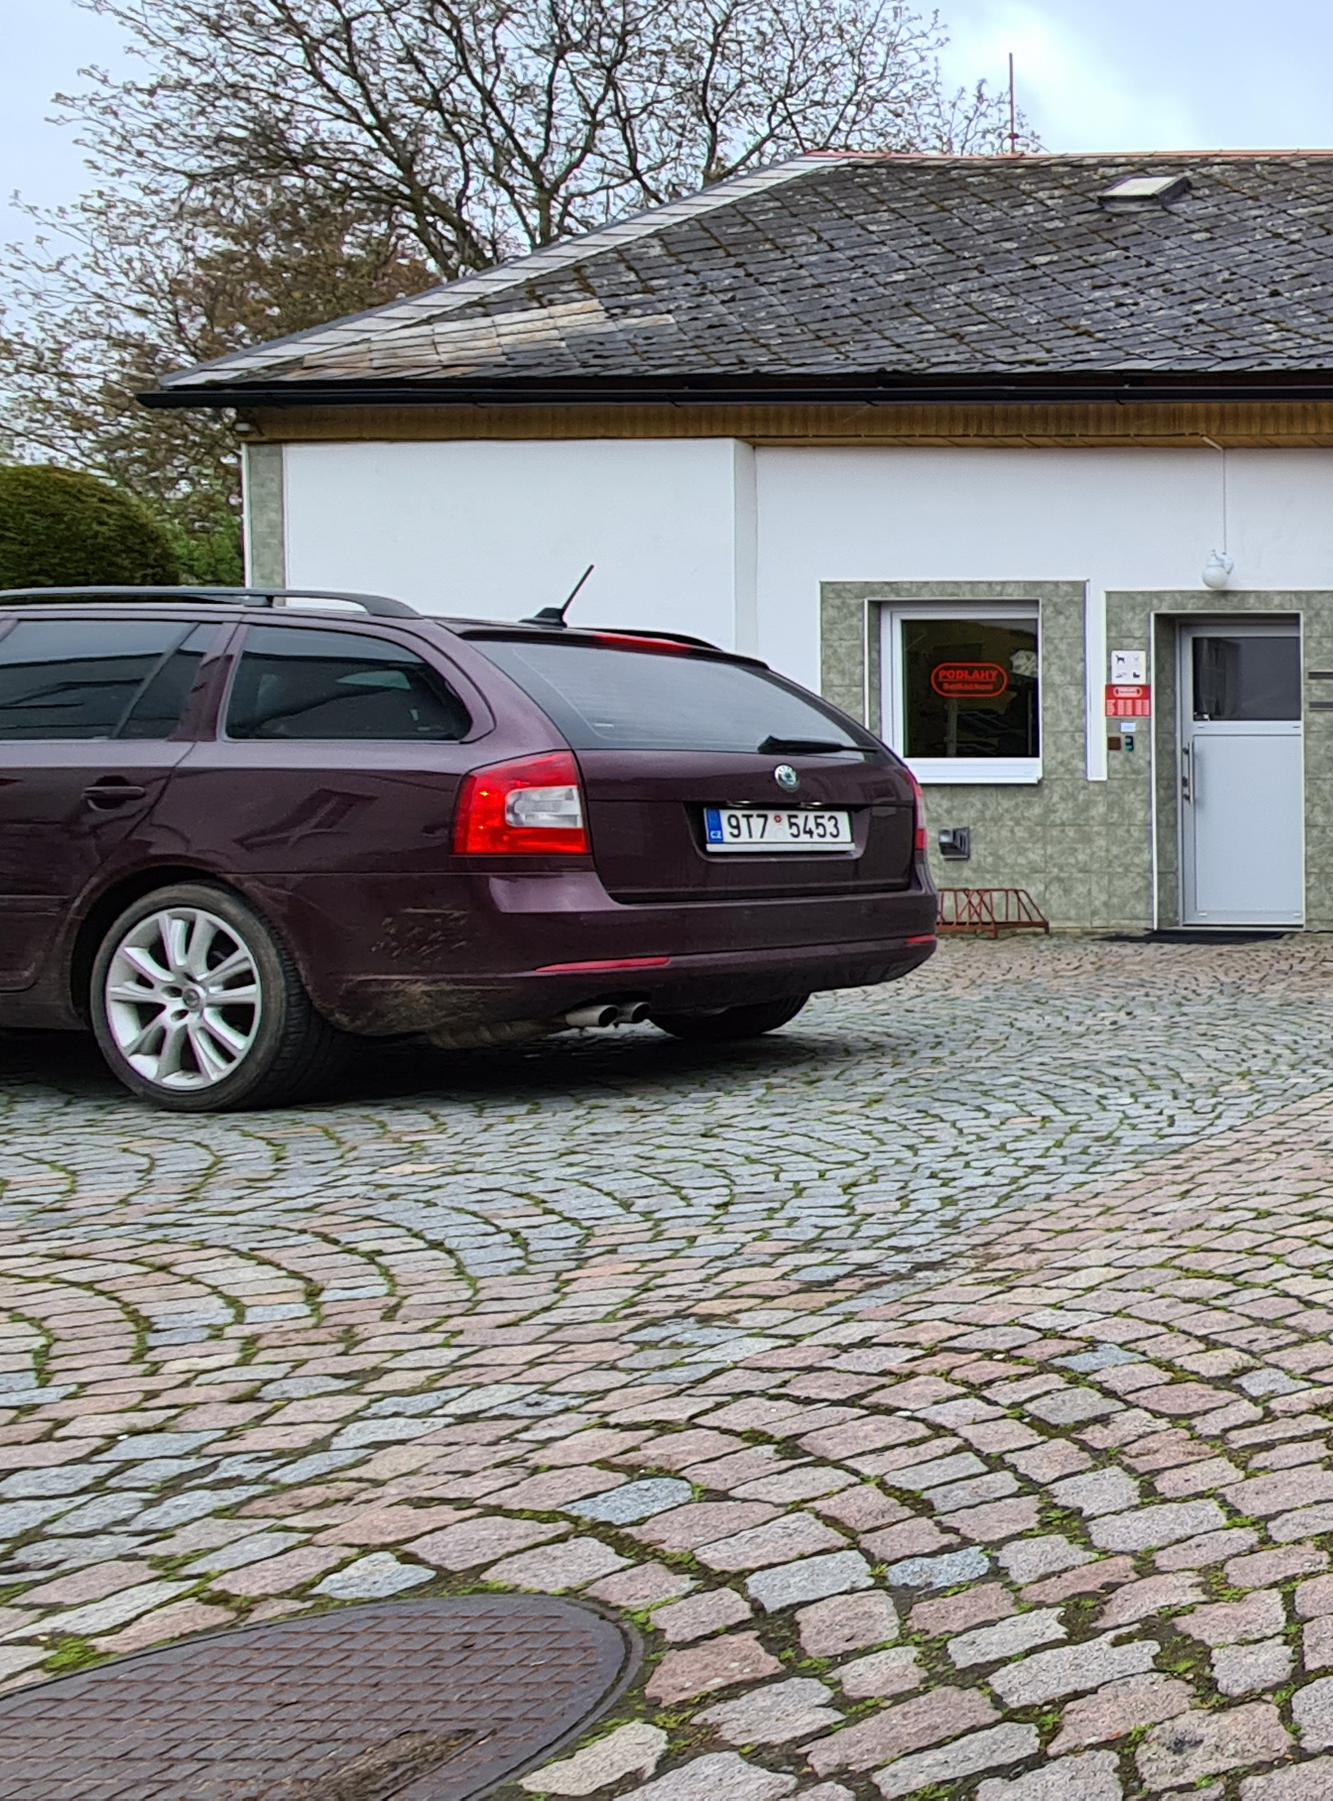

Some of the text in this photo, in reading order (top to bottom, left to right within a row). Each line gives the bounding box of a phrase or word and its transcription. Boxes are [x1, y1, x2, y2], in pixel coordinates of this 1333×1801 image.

[938, 670, 999, 681] PODLAHY
[727, 814, 840, 839] 9T7 5453
